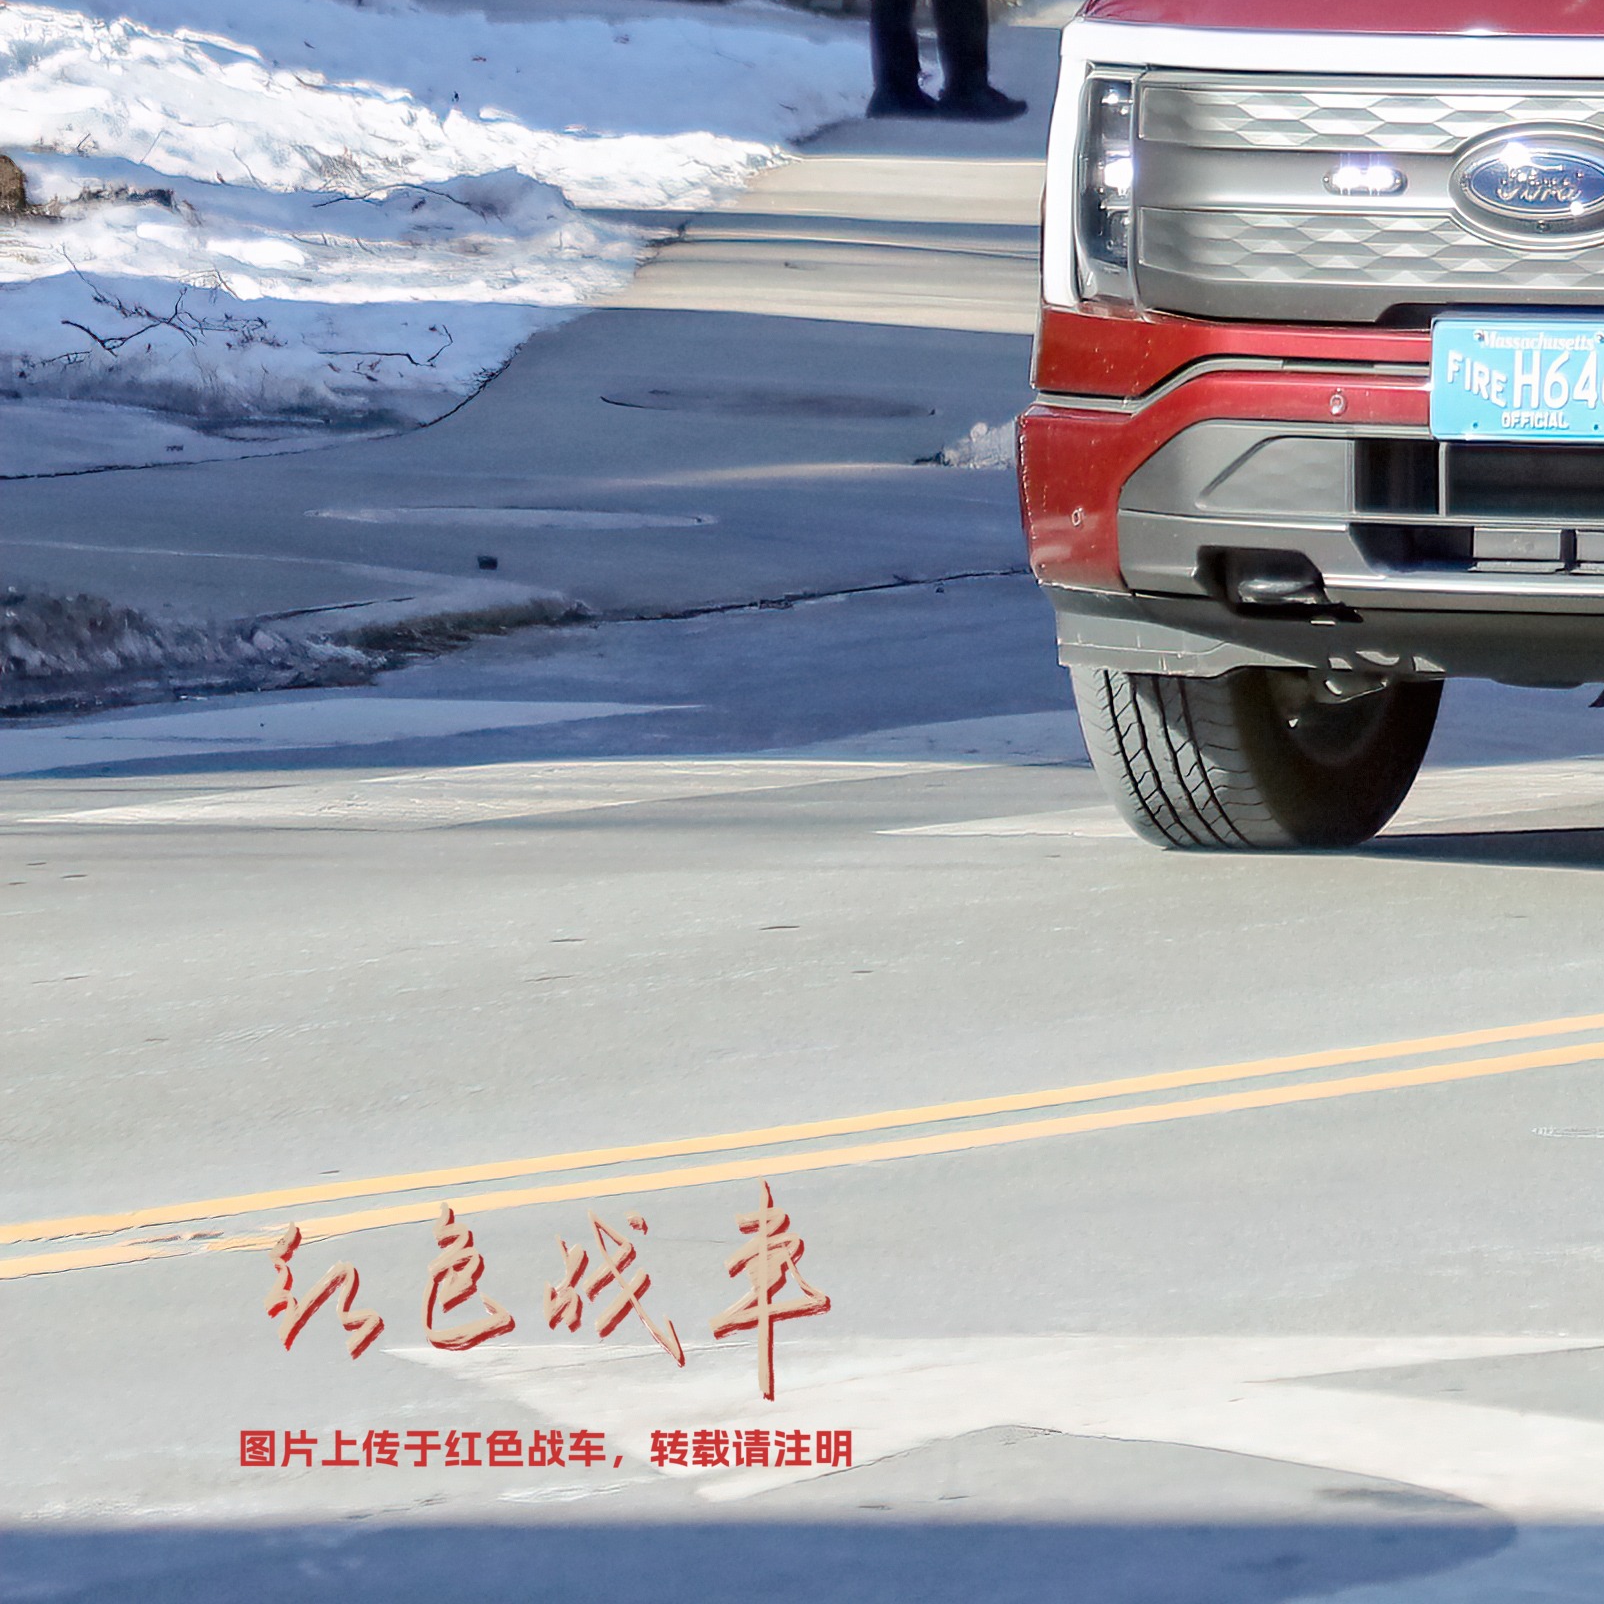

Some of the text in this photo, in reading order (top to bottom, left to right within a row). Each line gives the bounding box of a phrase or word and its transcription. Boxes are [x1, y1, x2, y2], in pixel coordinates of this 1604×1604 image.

[1497, 160, 1583, 202] Ford
[1480, 330, 1597, 351] Massachusetts
[1447, 349, 1508, 408] FIRE
[1501, 410, 1570, 430] OFFICIAL
